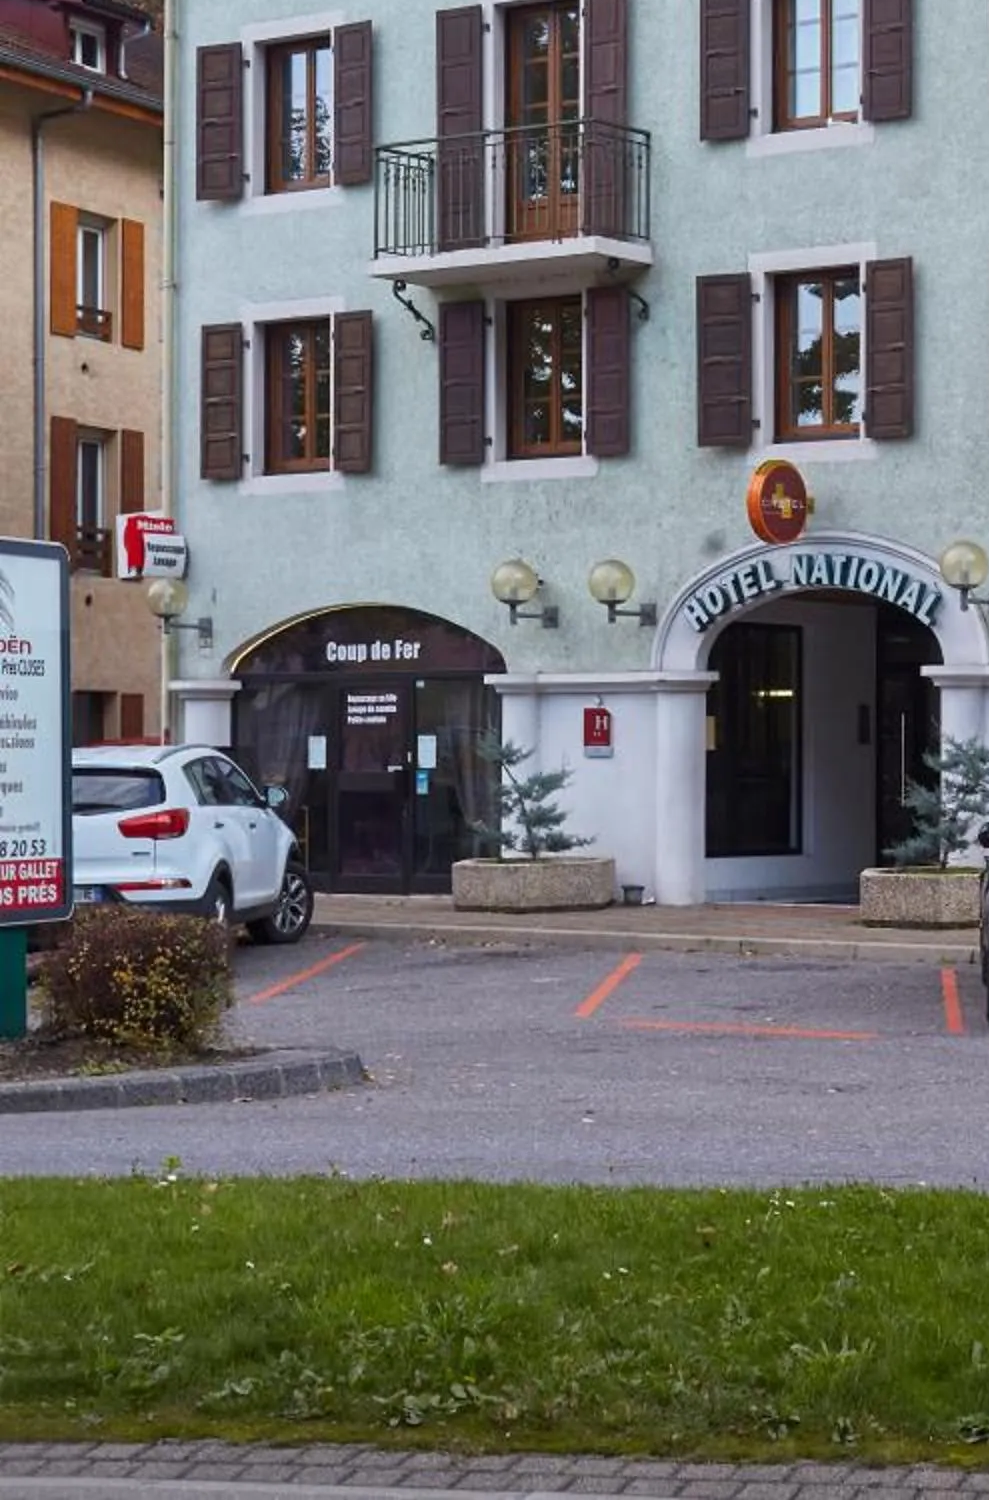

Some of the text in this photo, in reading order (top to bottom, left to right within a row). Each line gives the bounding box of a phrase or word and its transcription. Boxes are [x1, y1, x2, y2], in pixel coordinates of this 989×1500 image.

[680, 553, 945, 632] HOTEL NATIONAL
[327, 639, 421, 663] Coup de Fer
[10, 839, 28, 857] 20
[30, 839, 46, 856] 53
[0, 860, 58, 881] UR GALLET
